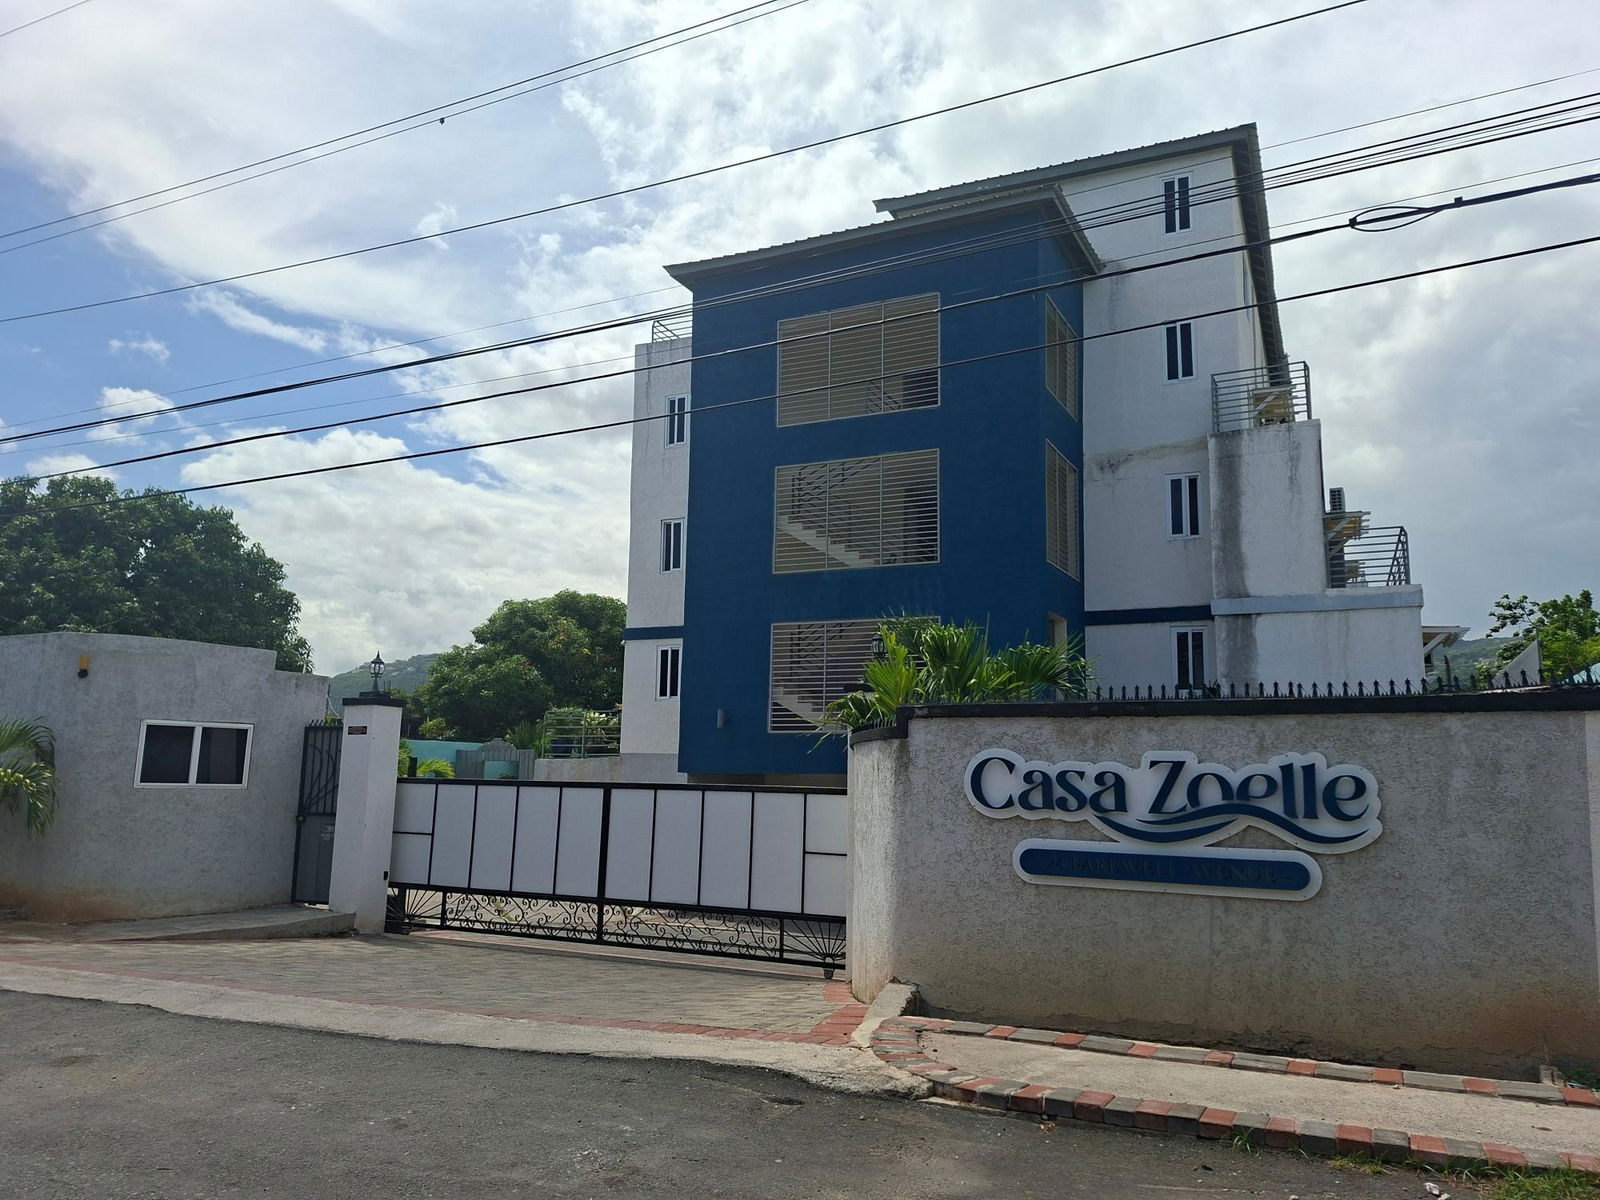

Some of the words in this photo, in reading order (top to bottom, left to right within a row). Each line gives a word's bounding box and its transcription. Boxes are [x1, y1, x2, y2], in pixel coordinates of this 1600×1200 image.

[969, 757, 1128, 813] Casa
[1148, 760, 1370, 822] Zoelle
[1071, 856, 1176, 878] FAREWELL
[1184, 863, 1278, 884] AVENUE
